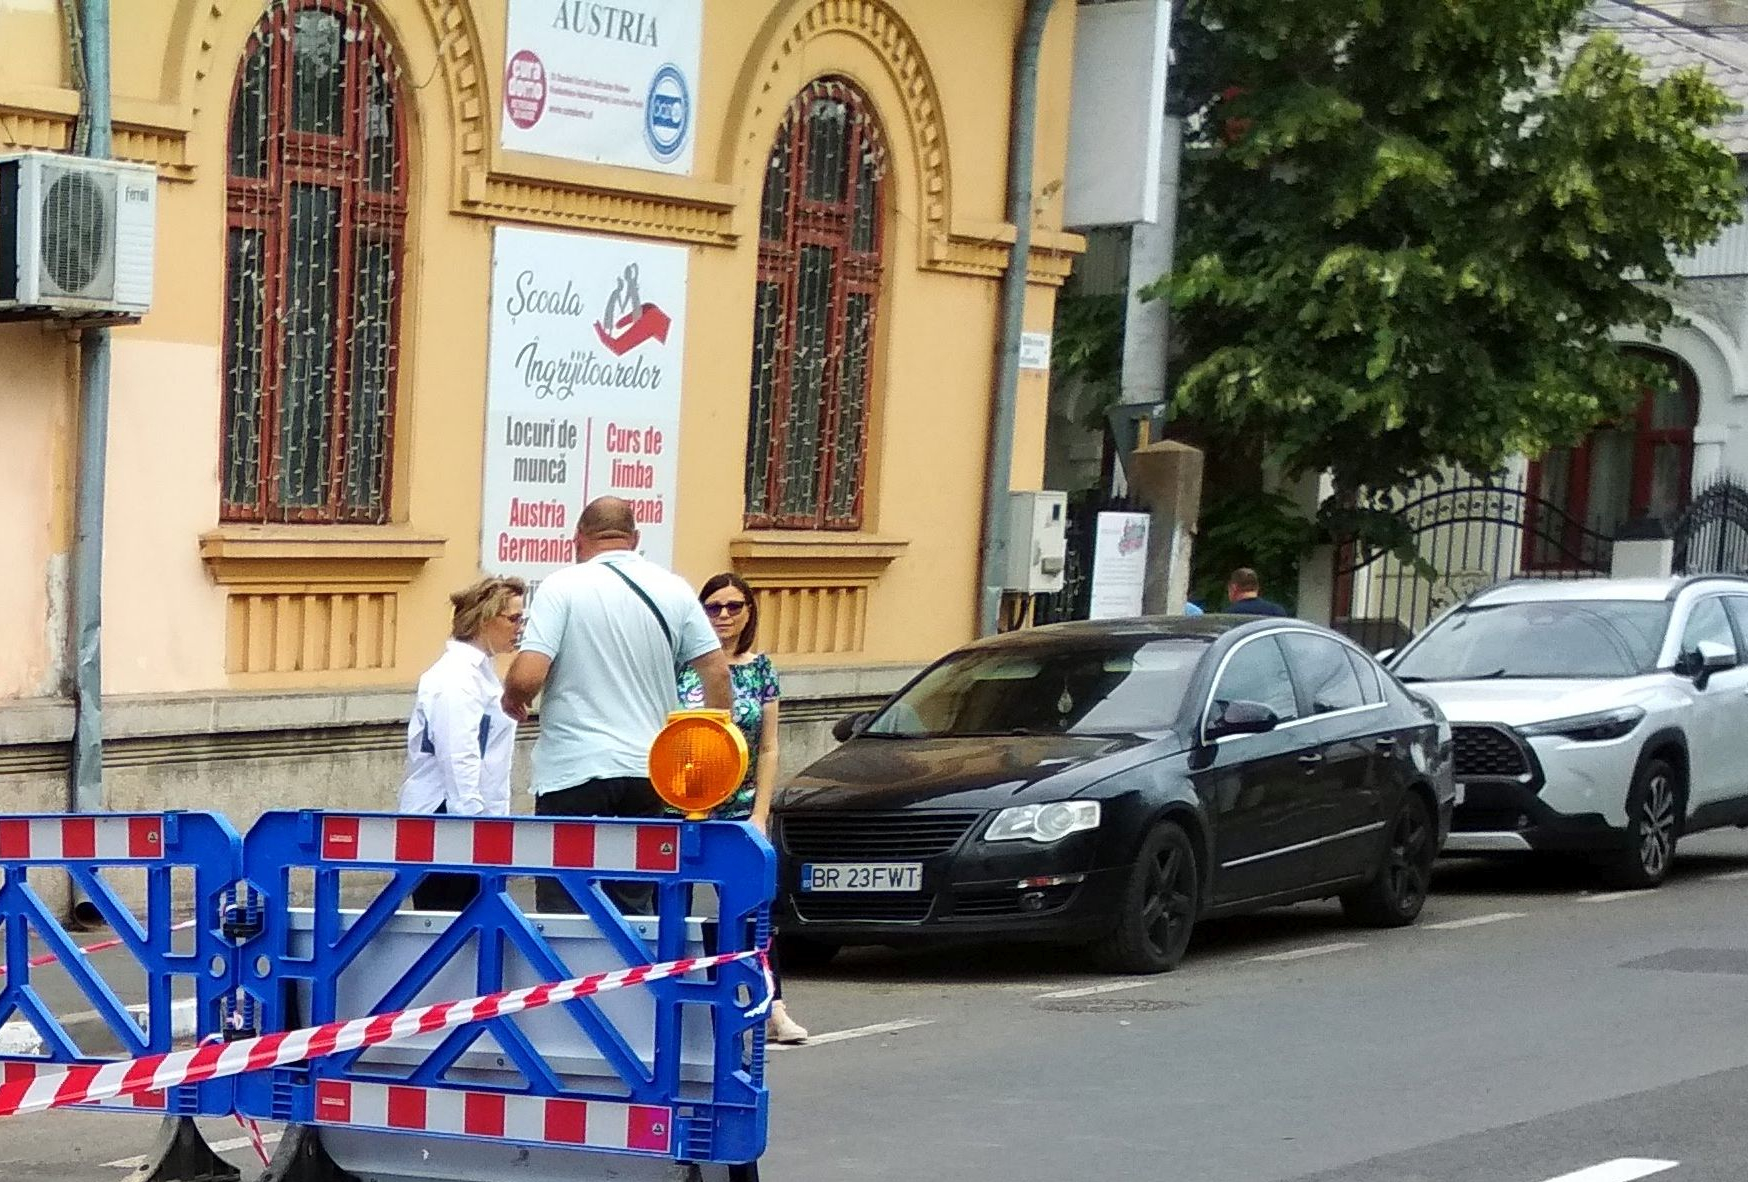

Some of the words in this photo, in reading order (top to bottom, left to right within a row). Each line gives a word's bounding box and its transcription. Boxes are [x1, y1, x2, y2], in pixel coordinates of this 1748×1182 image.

[553, 0, 659, 48] AUSTRIA
[506, 270, 584, 325] Școala
[515, 335, 663, 401] Îngrijitoarelor
[506, 415, 555, 448] Locuri
[558, 422, 577, 449] de
[606, 422, 640, 453] Curs
[643, 426, 663, 454] de
[513, 453, 567, 484] muncă
[611, 459, 653, 490] limba
[509, 497, 565, 529] Austria
[498, 532, 574, 563] Germania
[812, 867, 840, 888] BR
